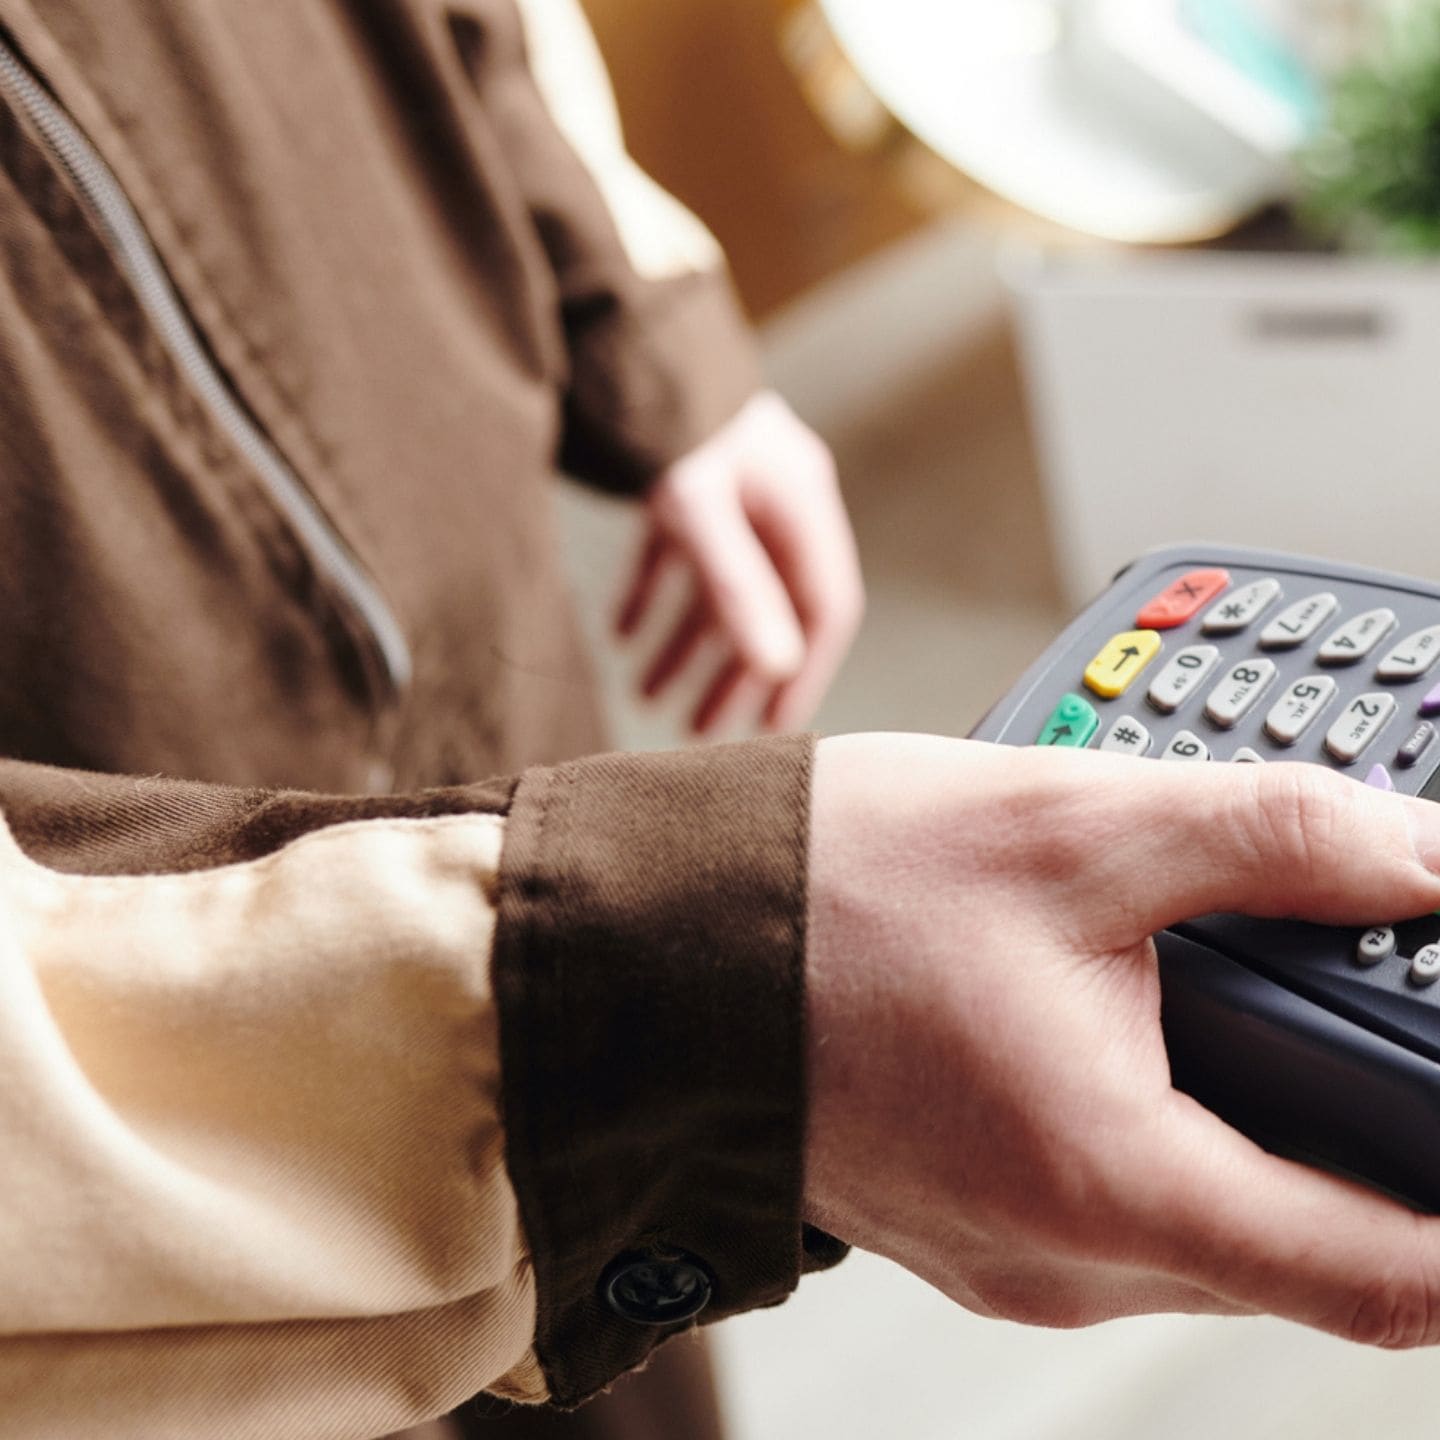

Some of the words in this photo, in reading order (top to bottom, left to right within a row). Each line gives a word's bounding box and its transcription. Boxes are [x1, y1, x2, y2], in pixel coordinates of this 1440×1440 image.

[1278, 620, 1303, 635] 7
[1332, 635, 1356, 650] 4
[1177, 654, 1203, 669] 0
[1391, 655, 1417, 667] 1
[1232, 667, 1260, 684] 8
[1229, 687, 1250, 705] TUV
[1293, 683, 1321, 700] 5
[1290, 703, 1310, 718] JKL
[1350, 699, 1380, 717] 2
[1113, 727, 1141, 745] #
[1349, 719, 1370, 739] ABC
[1171, 740, 1200, 757] 9
[1367, 929, 1387, 946] F4
[1420, 949, 1440, 966] F3
